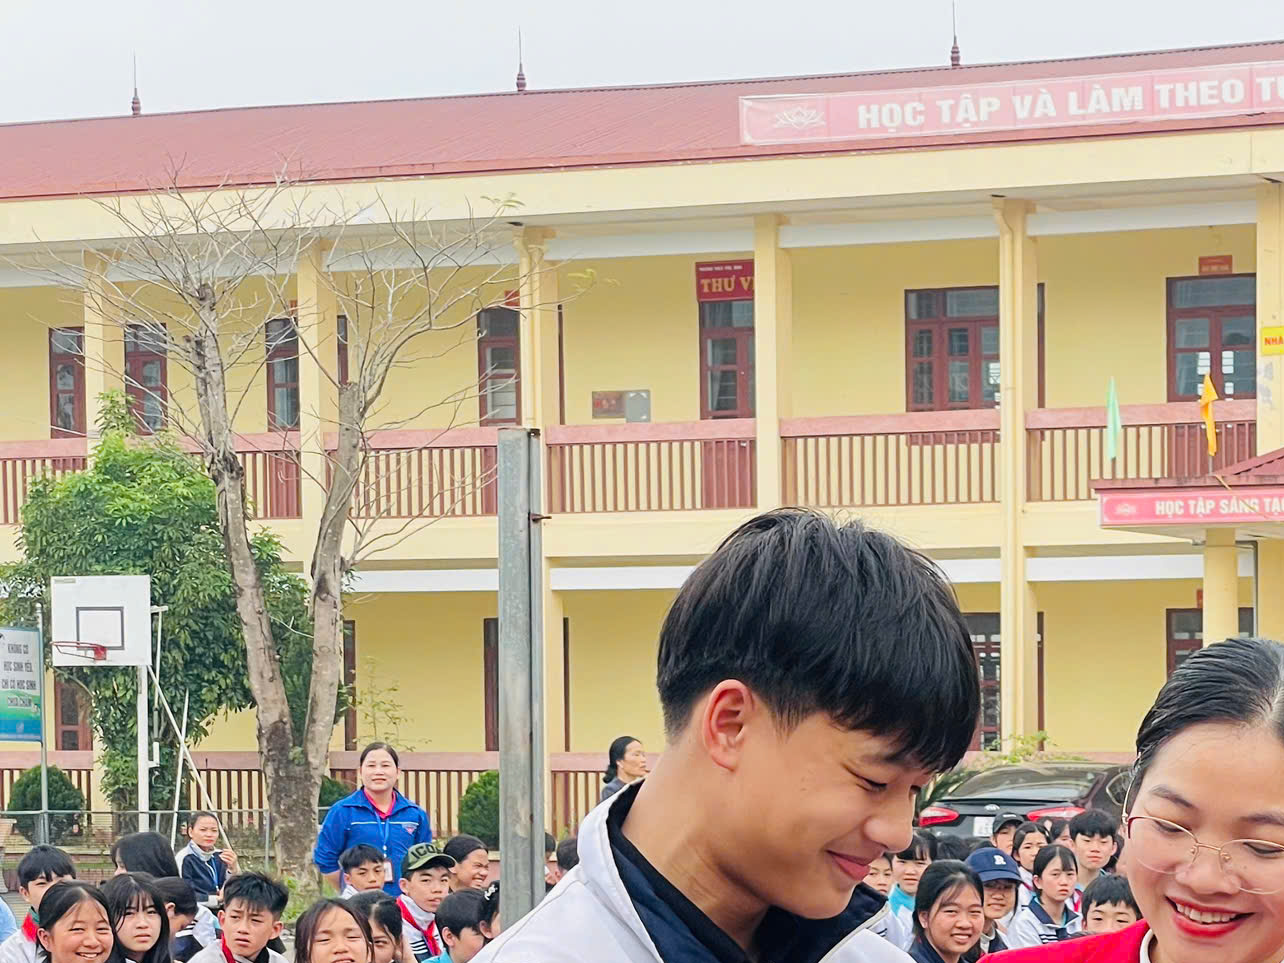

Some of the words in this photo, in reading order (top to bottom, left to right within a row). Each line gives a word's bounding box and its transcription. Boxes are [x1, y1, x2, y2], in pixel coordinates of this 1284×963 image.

[858, 102, 925, 132] HỌC
[936, 94, 1000, 128] TẬP
[1012, 88, 1057, 120] VÀ
[1068, 84, 1144, 115] LÀM
[1154, 78, 1245, 109] THEO
[701, 275, 736, 293] THƯ
[1155, 501, 1184, 519] HỌC
[1188, 497, 1215, 518] TẬP
[1219, 496, 1260, 515] SÁNG
